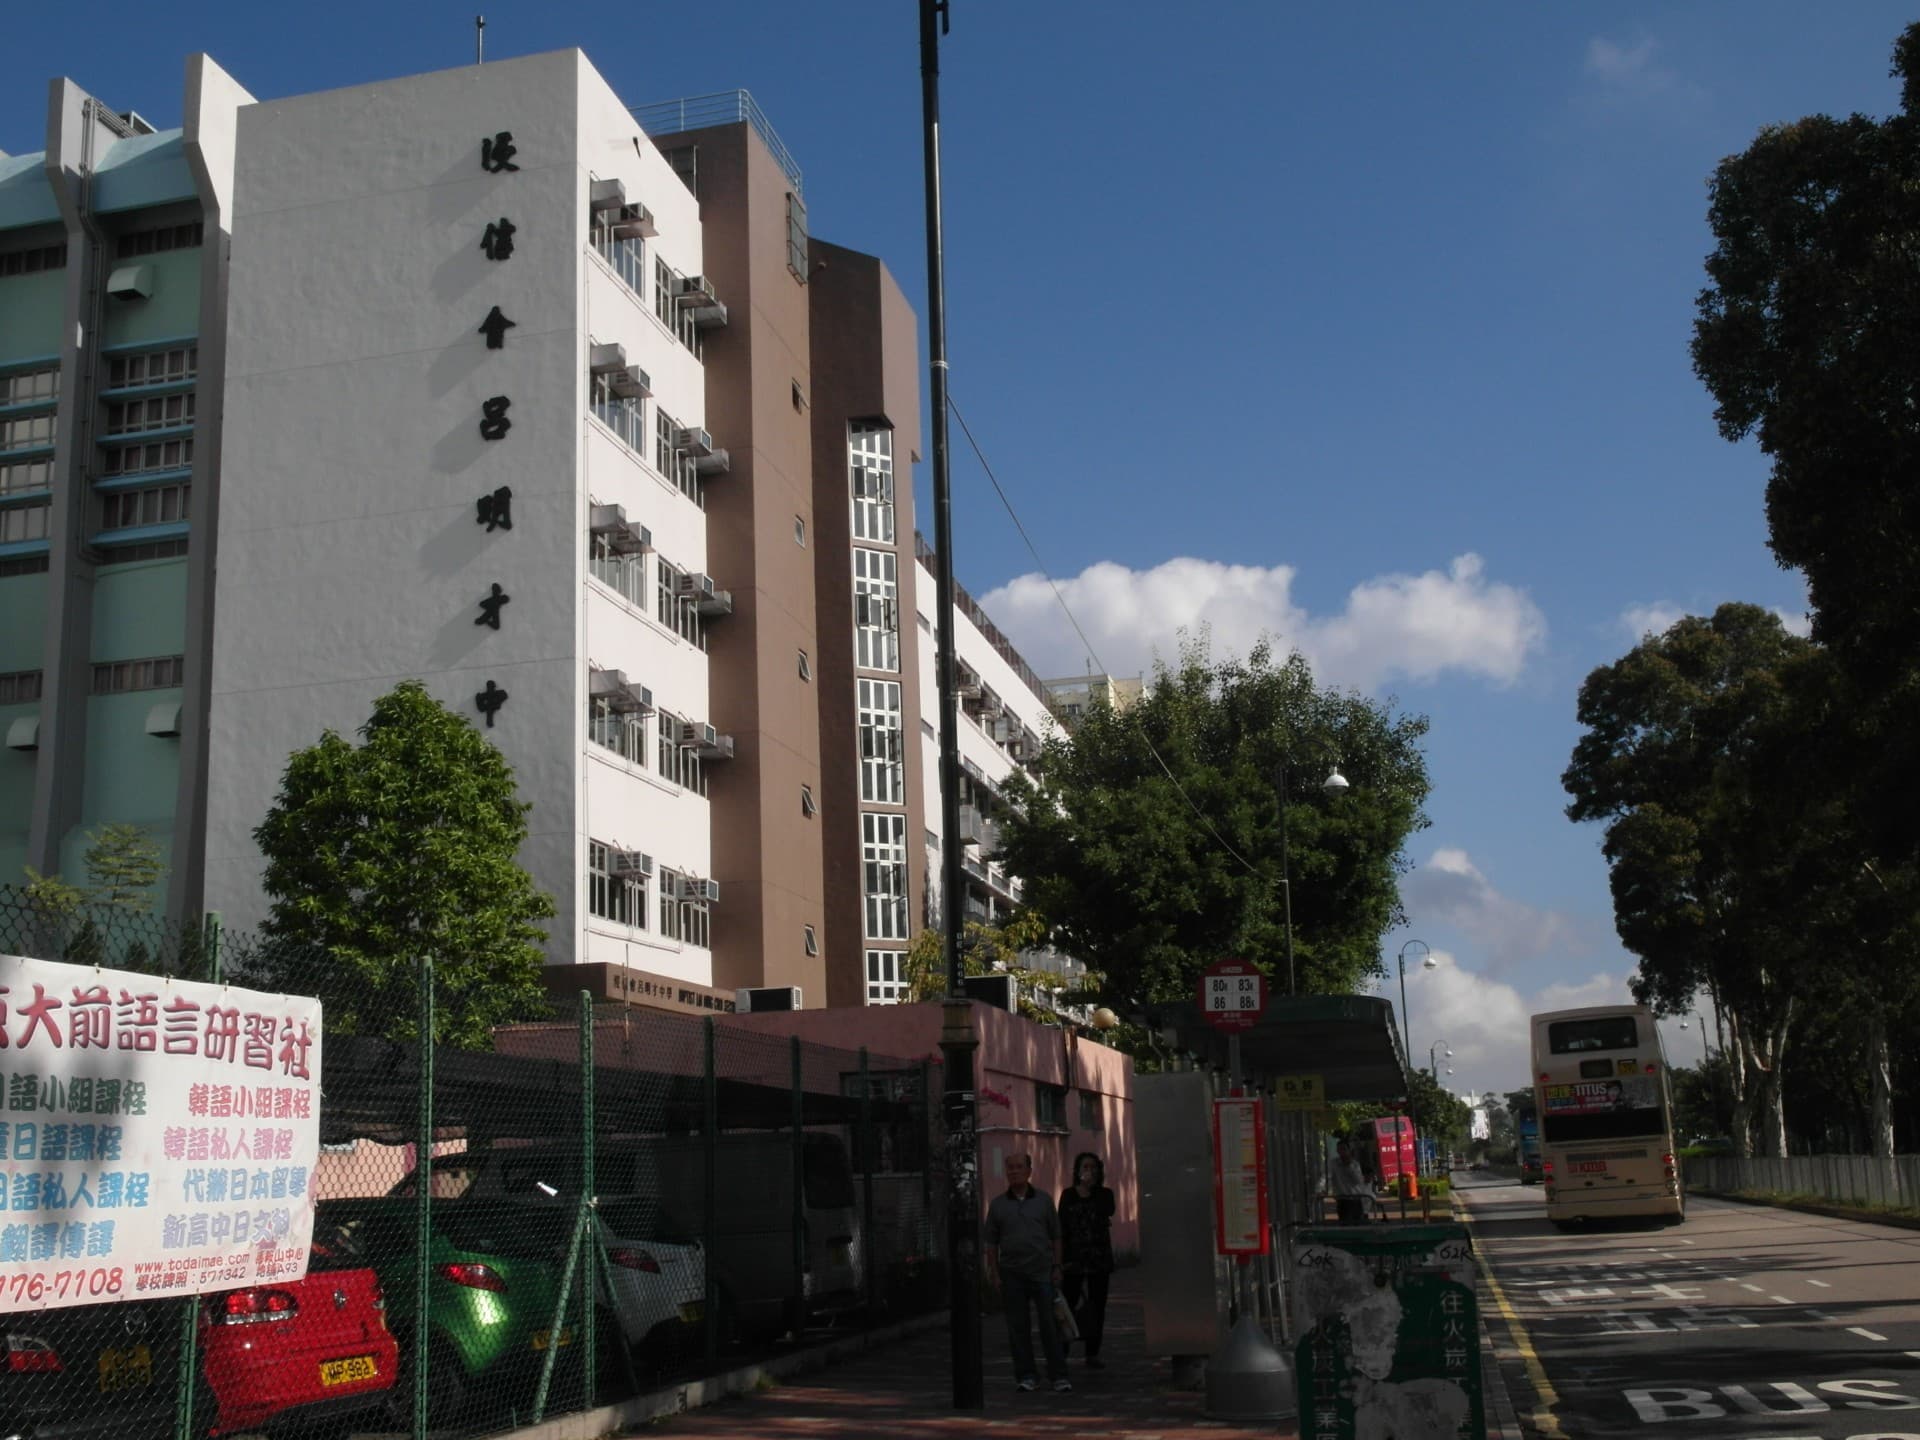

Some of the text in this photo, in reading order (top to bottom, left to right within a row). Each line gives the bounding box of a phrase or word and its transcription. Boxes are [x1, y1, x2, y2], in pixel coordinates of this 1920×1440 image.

[0, 1073, 147, 1116] 語小組課程
[188, 1083, 311, 1120] 韓語小組課程
[1575, 1083, 1607, 1097] TITUS
[163, 1126, 294, 1161] 韓語私人課程
[134, 1252, 250, 1274] www.todaimae.com
[1622, 1379, 1920, 1424] BUS
